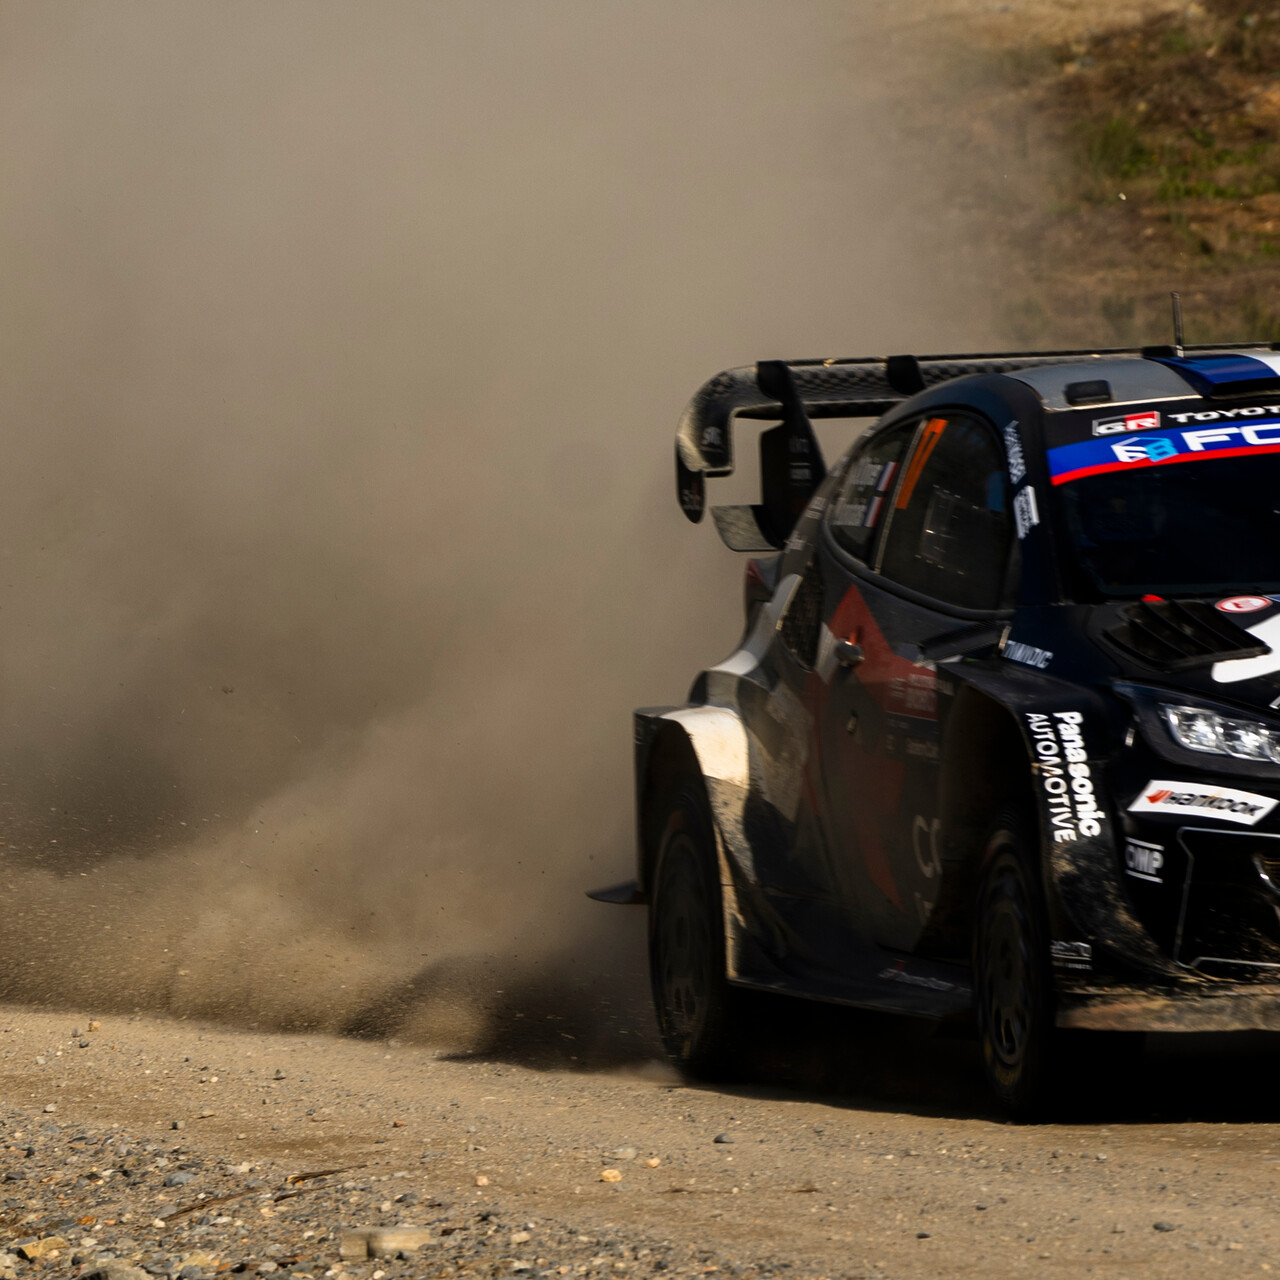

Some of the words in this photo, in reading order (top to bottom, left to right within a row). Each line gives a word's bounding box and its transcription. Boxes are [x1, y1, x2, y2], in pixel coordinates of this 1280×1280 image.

[1095, 414, 1159, 435] GR
[1026, 712, 1077, 843] AUTOMOTIVE
[1053, 710, 1106, 838] Panasonic
